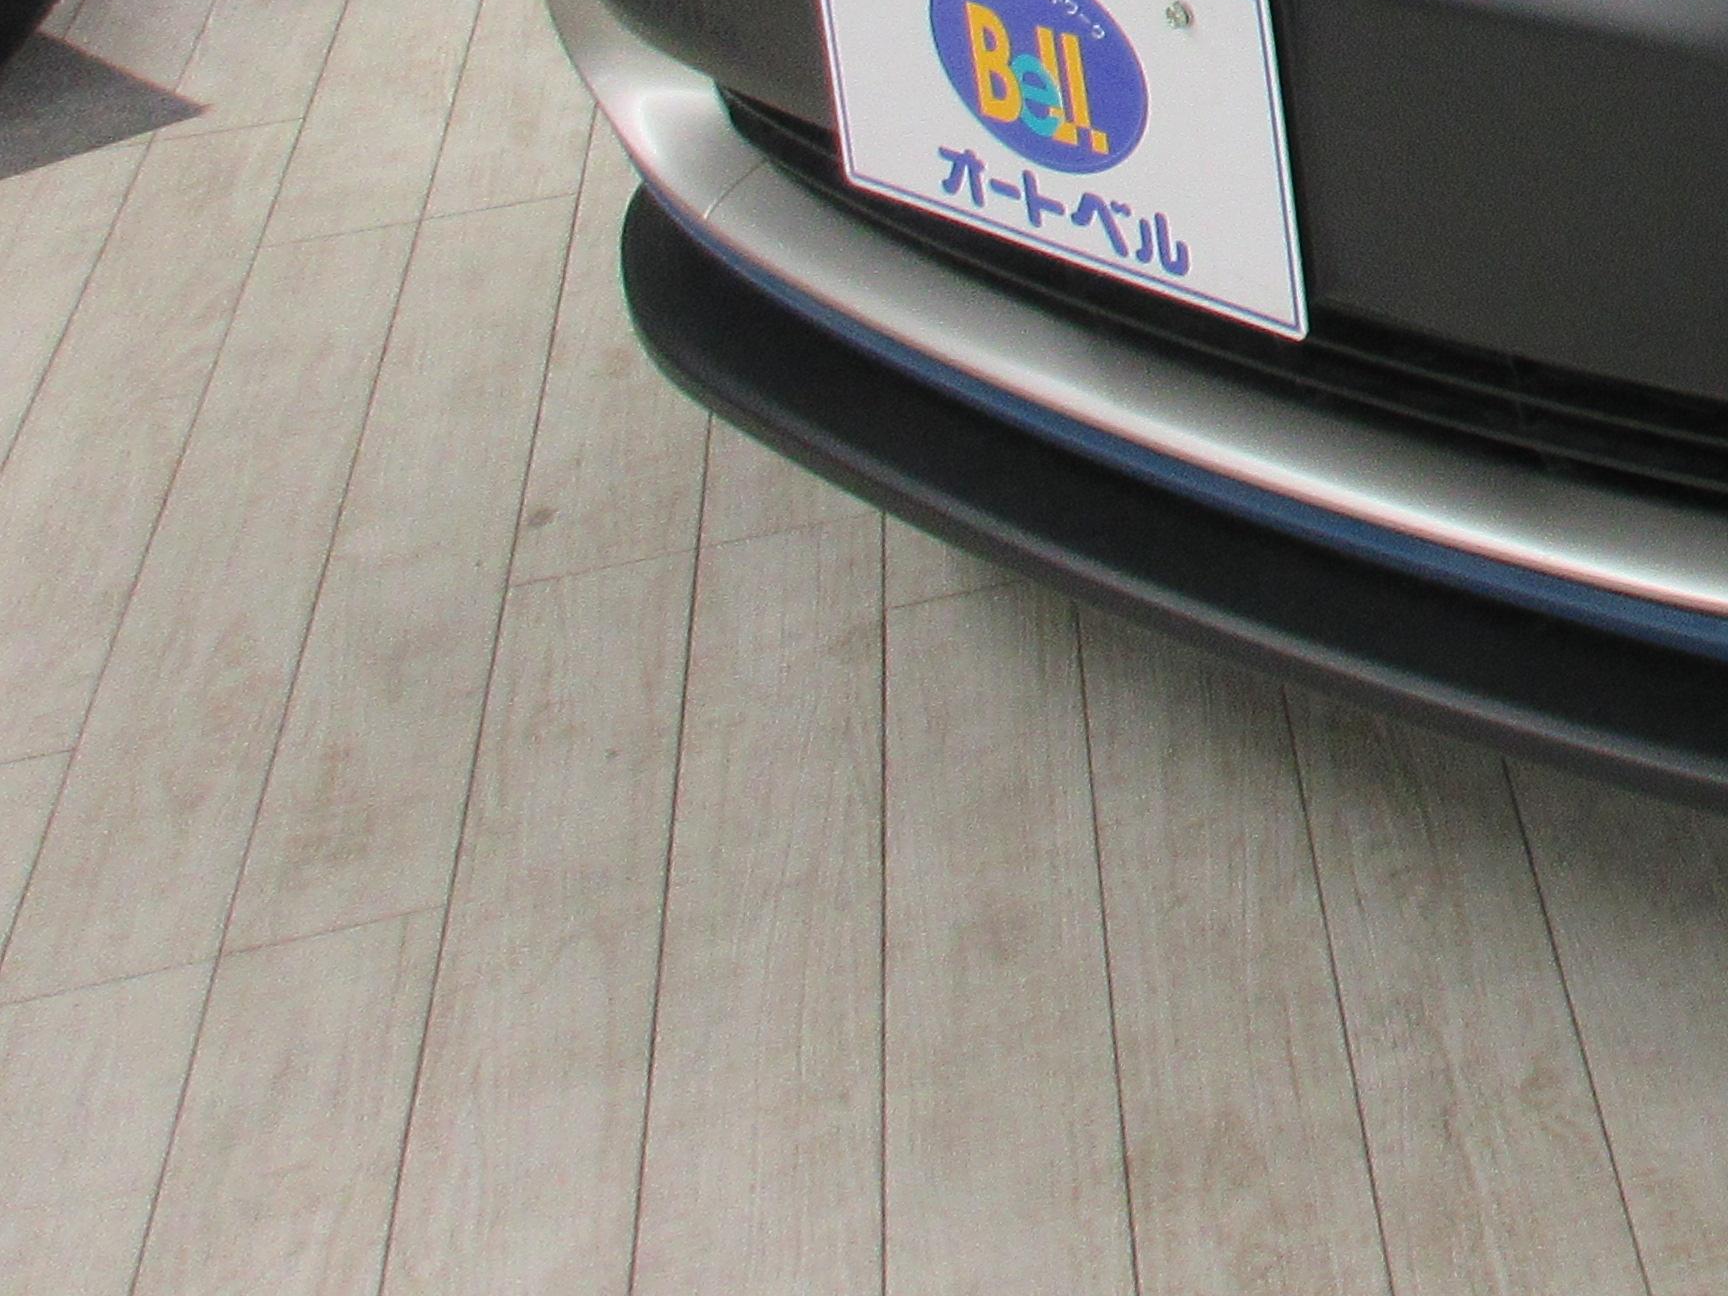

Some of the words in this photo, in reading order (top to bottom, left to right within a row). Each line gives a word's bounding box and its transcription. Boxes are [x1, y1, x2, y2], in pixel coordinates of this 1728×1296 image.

[936, 144, 1193, 278] オートベル
